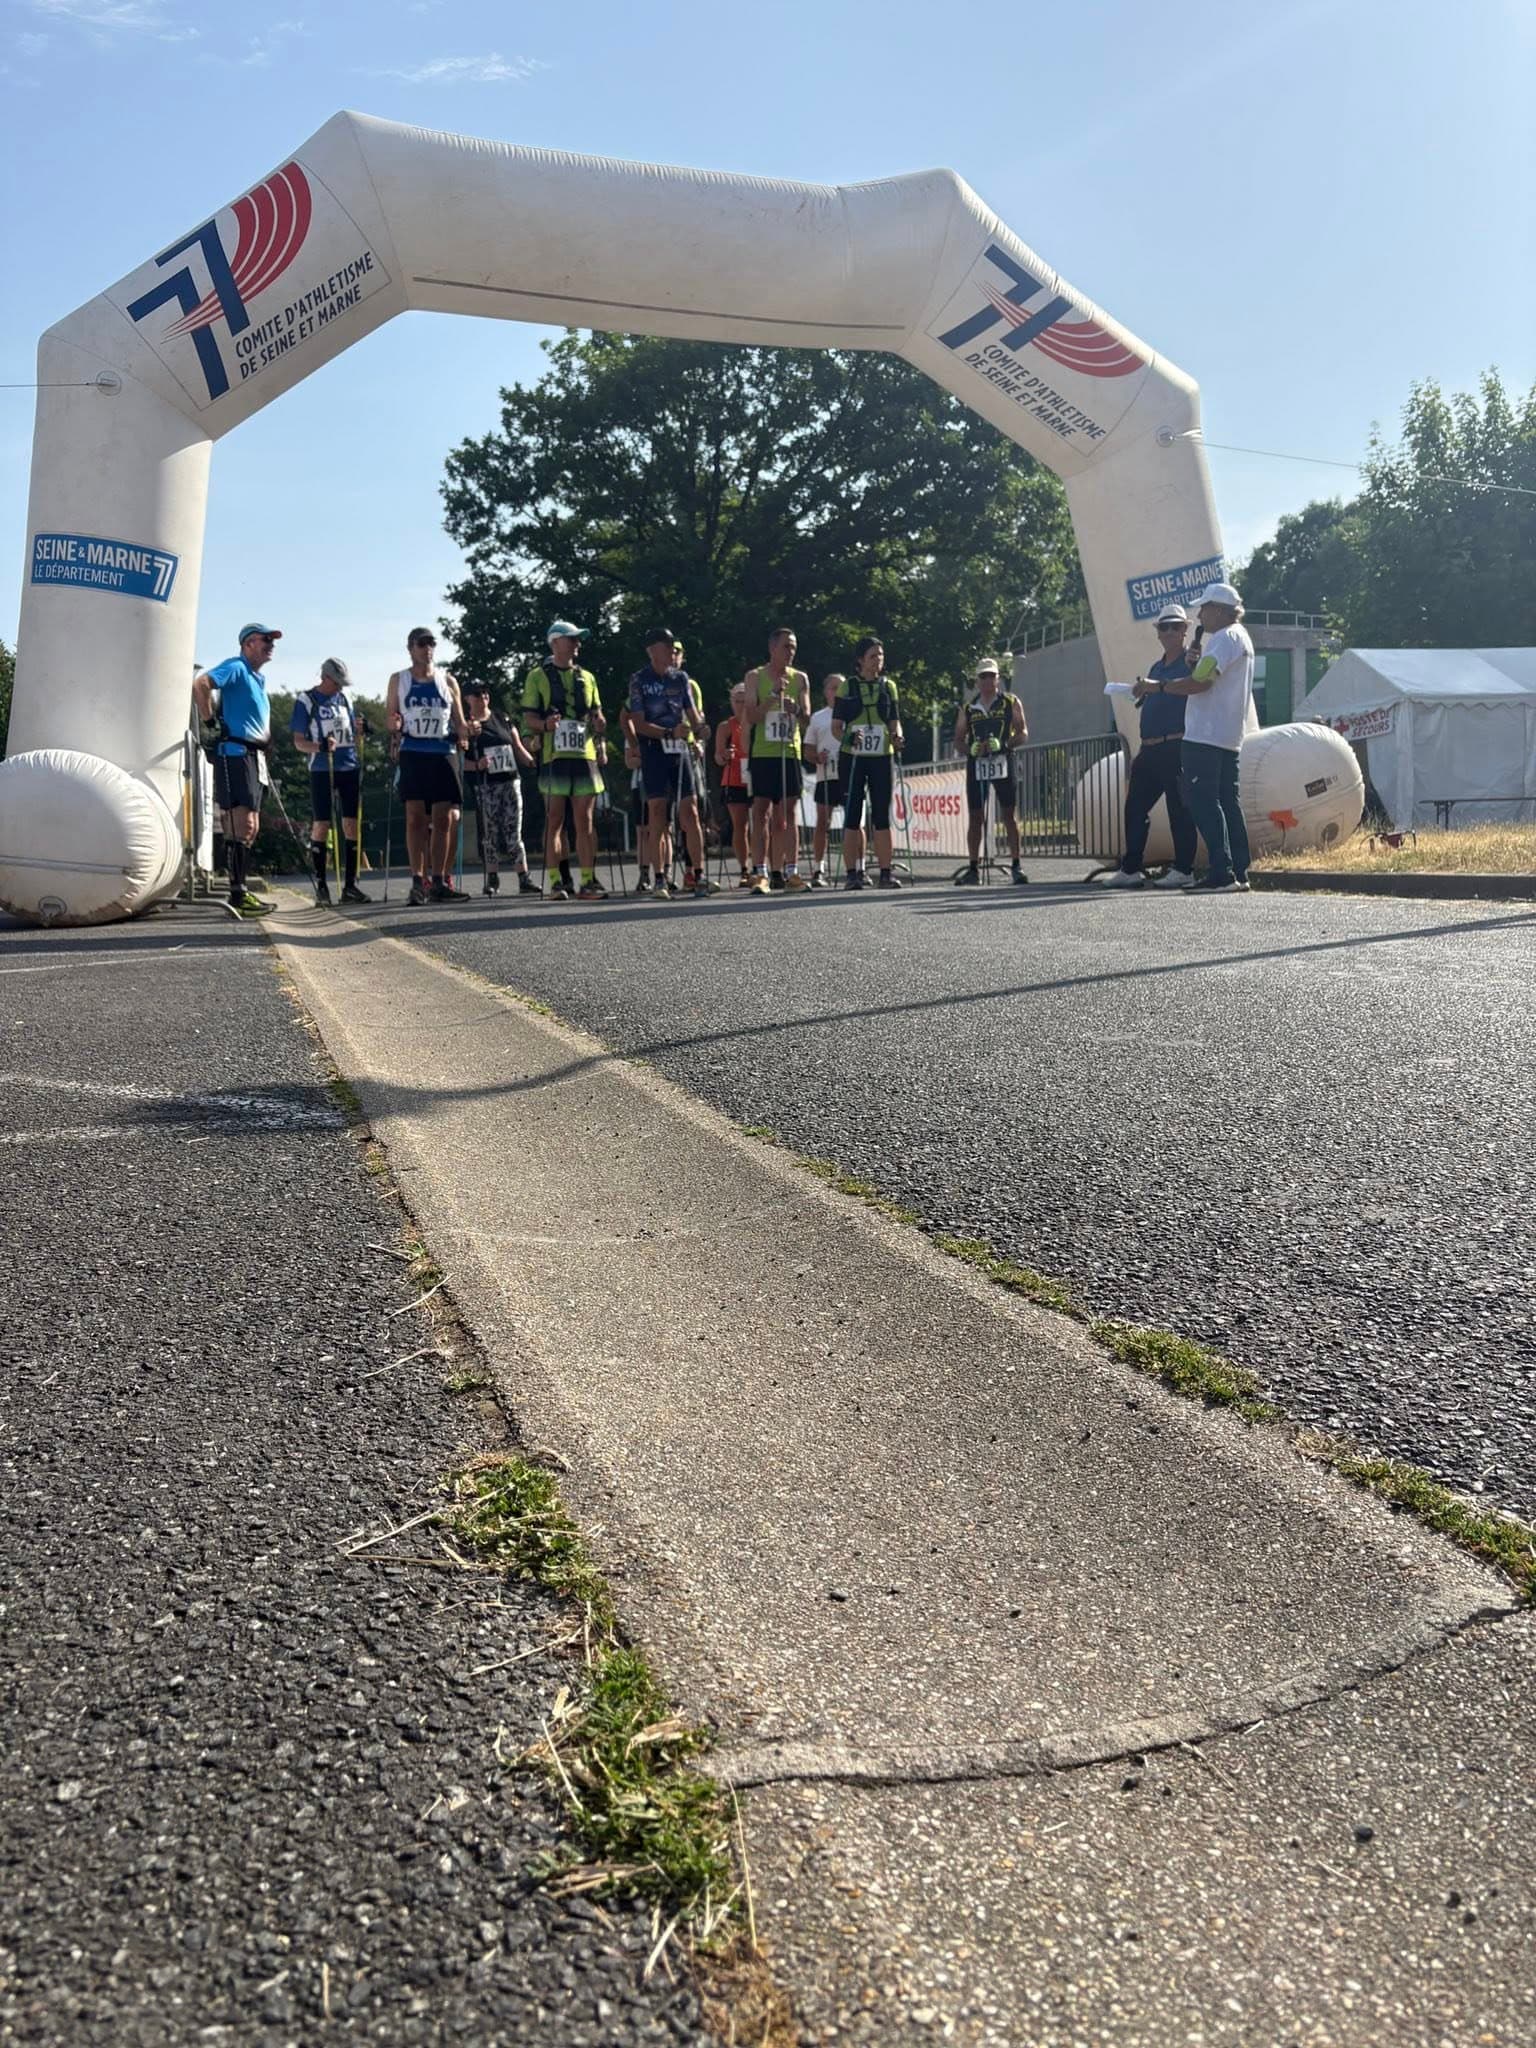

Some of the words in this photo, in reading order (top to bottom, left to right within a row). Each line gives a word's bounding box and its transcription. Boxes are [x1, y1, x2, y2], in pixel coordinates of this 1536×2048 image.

[235, 315, 283, 358] COMITE
[285, 251, 374, 328] D'ATHLETISME
[239, 357, 258, 379] DE
[260, 330, 296, 366] SEINE
[299, 315, 315, 338] ET
[318, 284, 362, 324] MARNE
[965, 352, 982, 370] DE
[982, 362, 1020, 396] SEINE
[1015, 390, 1036, 407] ET
[1031, 403, 1077, 438] MARNE
[982, 344, 1030, 382] COMITE
[1025, 376, 1106, 441] D'ATHLETISME
[35, 539, 77, 561] SEINE
[87, 543, 152, 575] MARNE
[34, 566, 43, 578] LE
[45, 563, 125, 588] DÉPARTEMENT
[152, 555, 174, 596] 77
[1132, 575, 1176, 600] SEINE
[1182, 562, 1222, 589] MARNE
[1136, 602, 1149, 616] LE
[414, 718, 440, 734] 177
[561, 731, 585, 748] 188
[1352, 720, 1390, 737] SECOURS
[492, 755, 512, 770] 174
[912, 794, 961, 821] express
